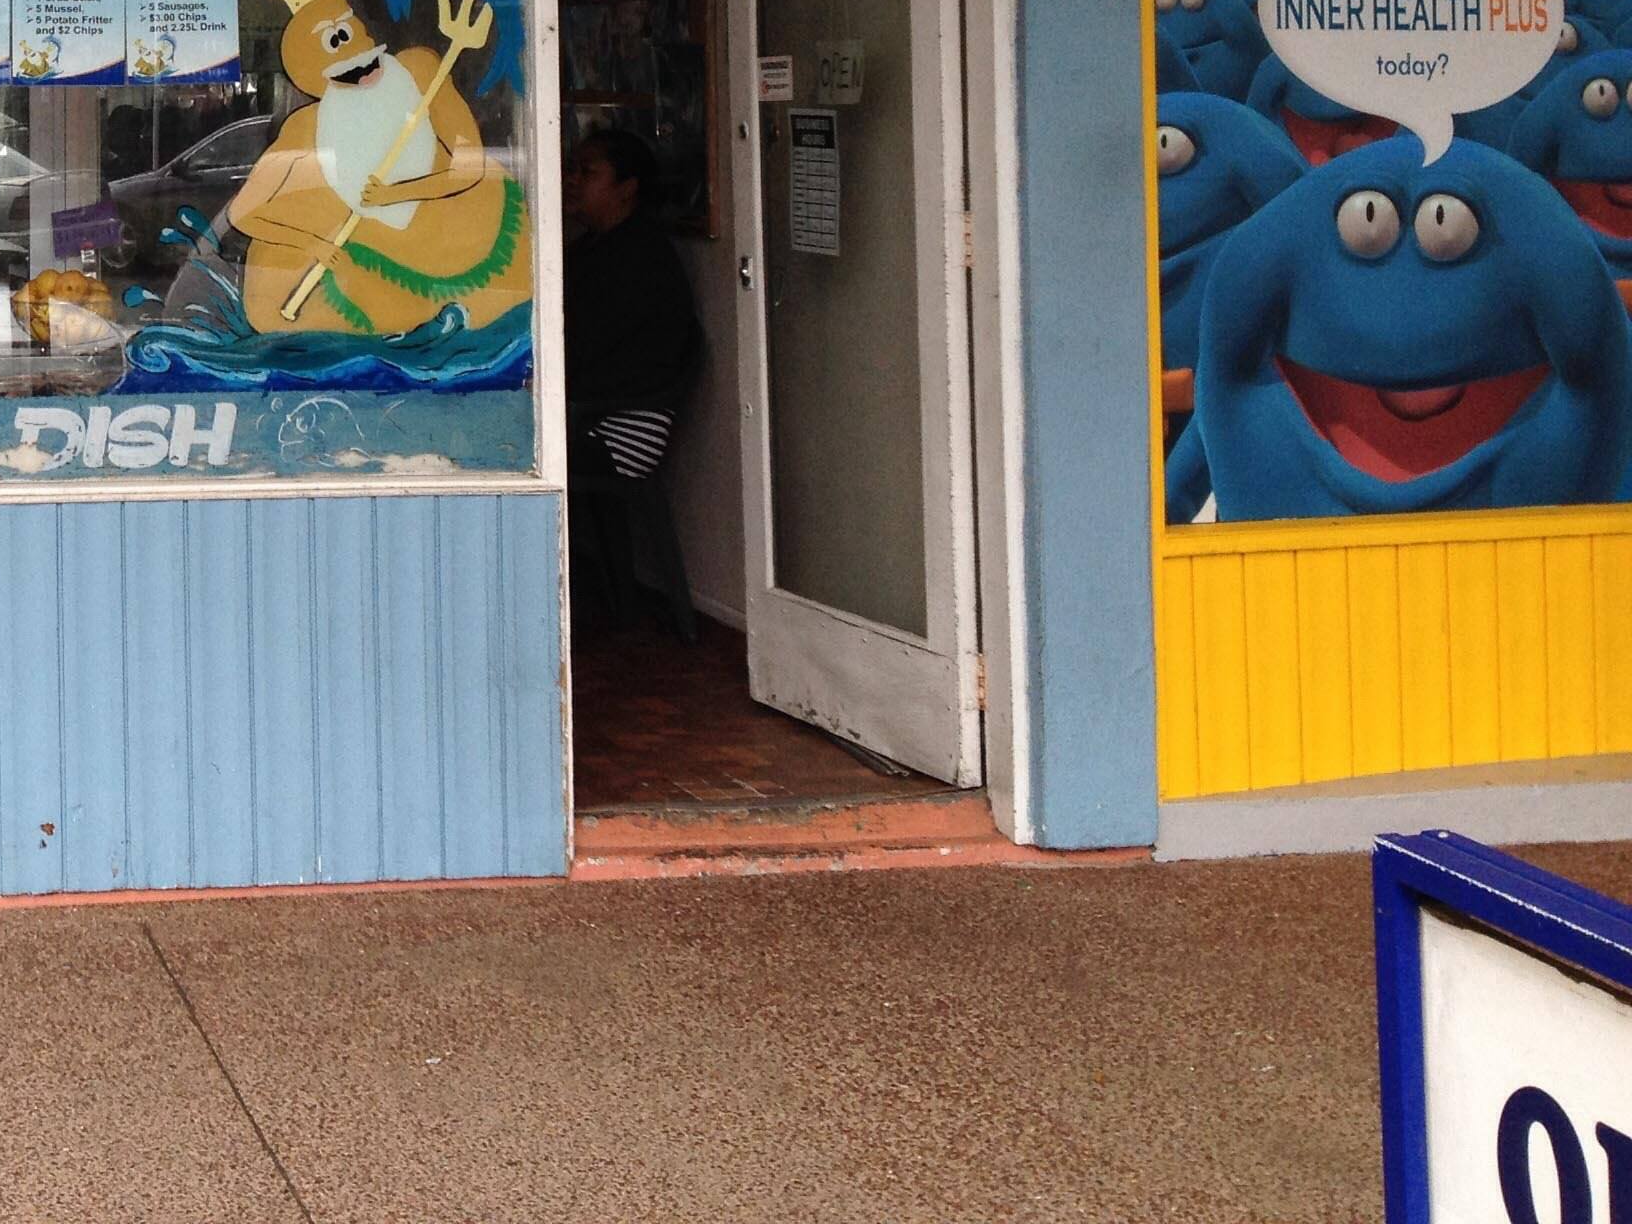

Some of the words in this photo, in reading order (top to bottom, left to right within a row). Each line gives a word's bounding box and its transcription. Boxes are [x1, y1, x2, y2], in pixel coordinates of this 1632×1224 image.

[44, 15, 79, 24] Potato
[81, 15, 113, 24] Fritter
[177, 12, 207, 22] Chips
[35, 26, 55, 35] and
[58, 25, 70, 35] $2
[72, 25, 103, 36] Chips
[149, 24, 168, 32] and
[170, 23, 198, 32] 2.25L
[200, 22, 226, 31] Drink
[1376, 52, 1448, 80] today?
[13, 401, 236, 471] DISH
